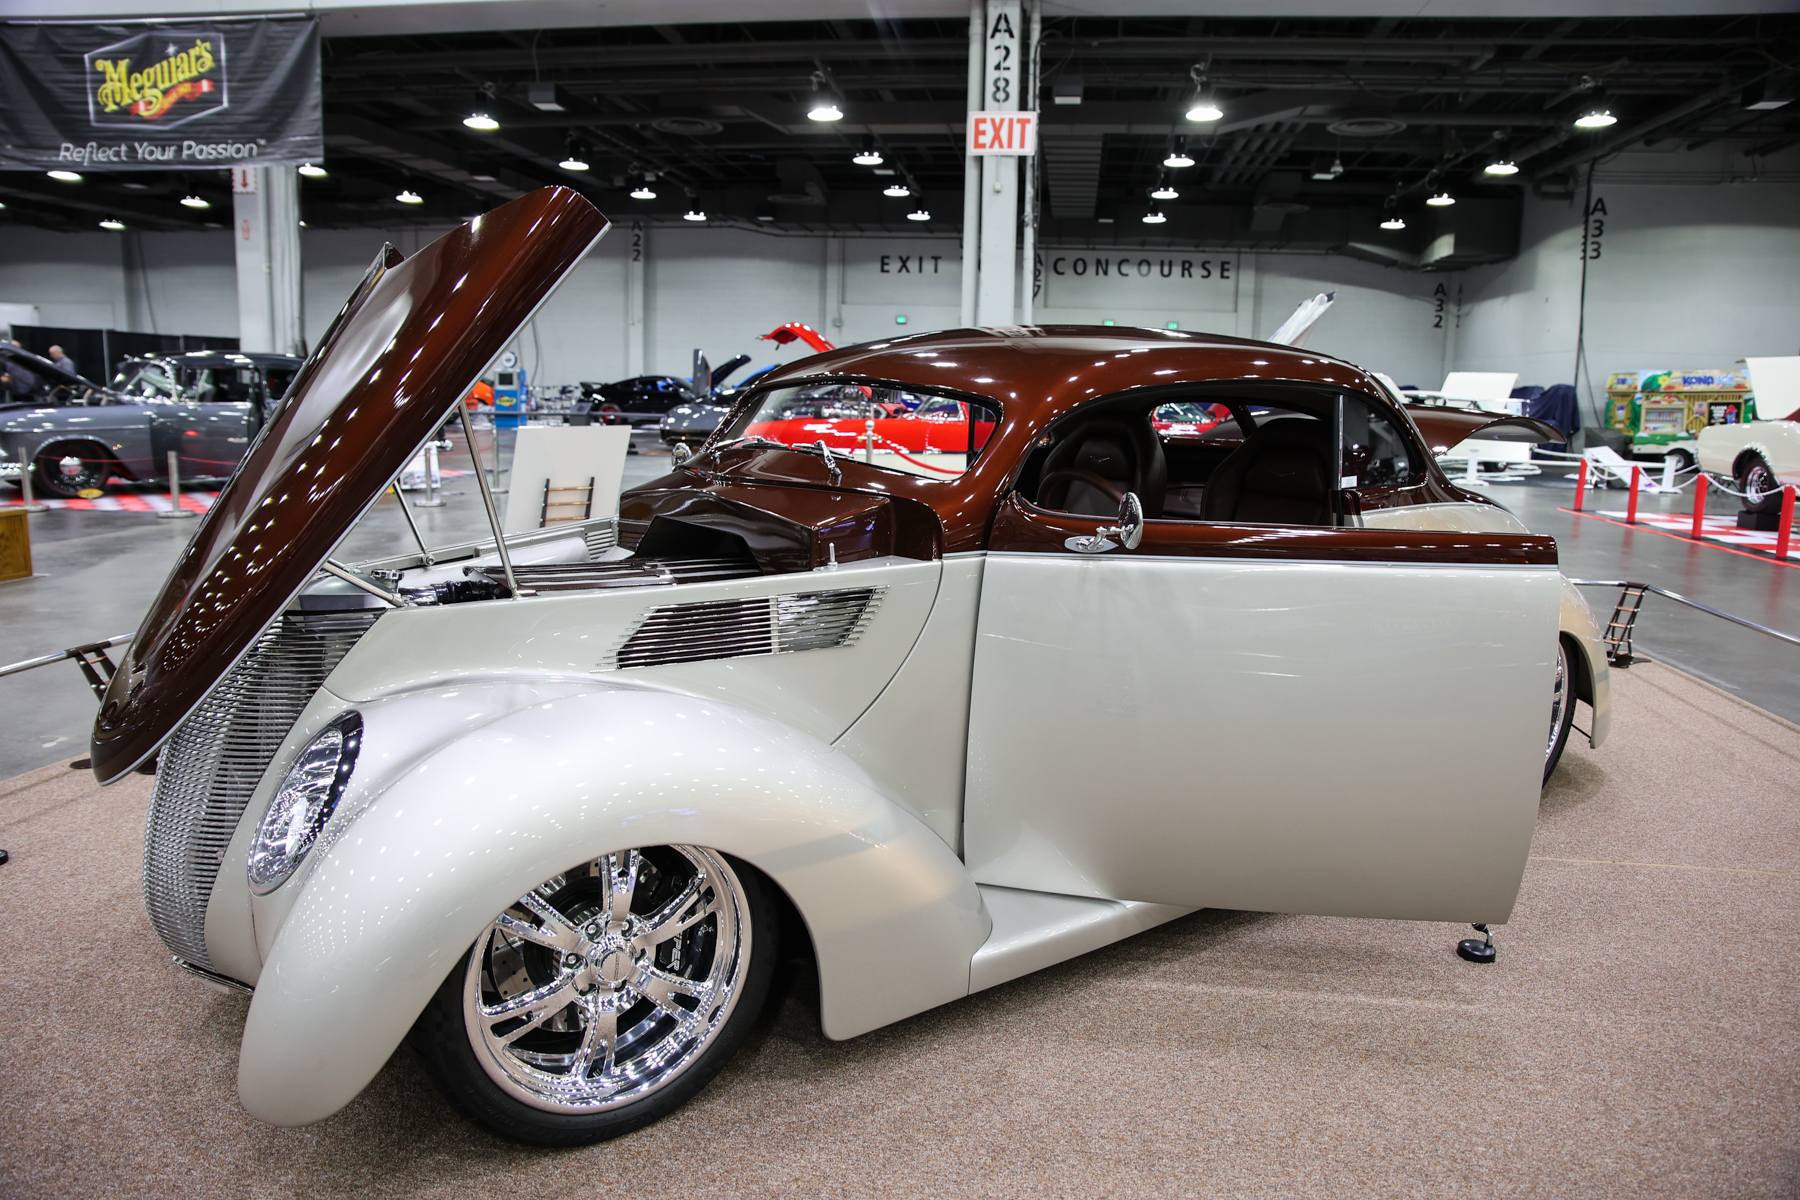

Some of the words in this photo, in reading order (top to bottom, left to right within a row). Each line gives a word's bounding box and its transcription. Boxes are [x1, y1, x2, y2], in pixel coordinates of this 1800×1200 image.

[95, 39, 215, 117] Meguiar's
[973, 118, 1031, 149] EXIT
[59, 142, 128, 166] Reflect
[134, 142, 177, 160] Your
[880, 255, 942, 273] EXIT
[1053, 257, 1232, 280] CONCOURSE
